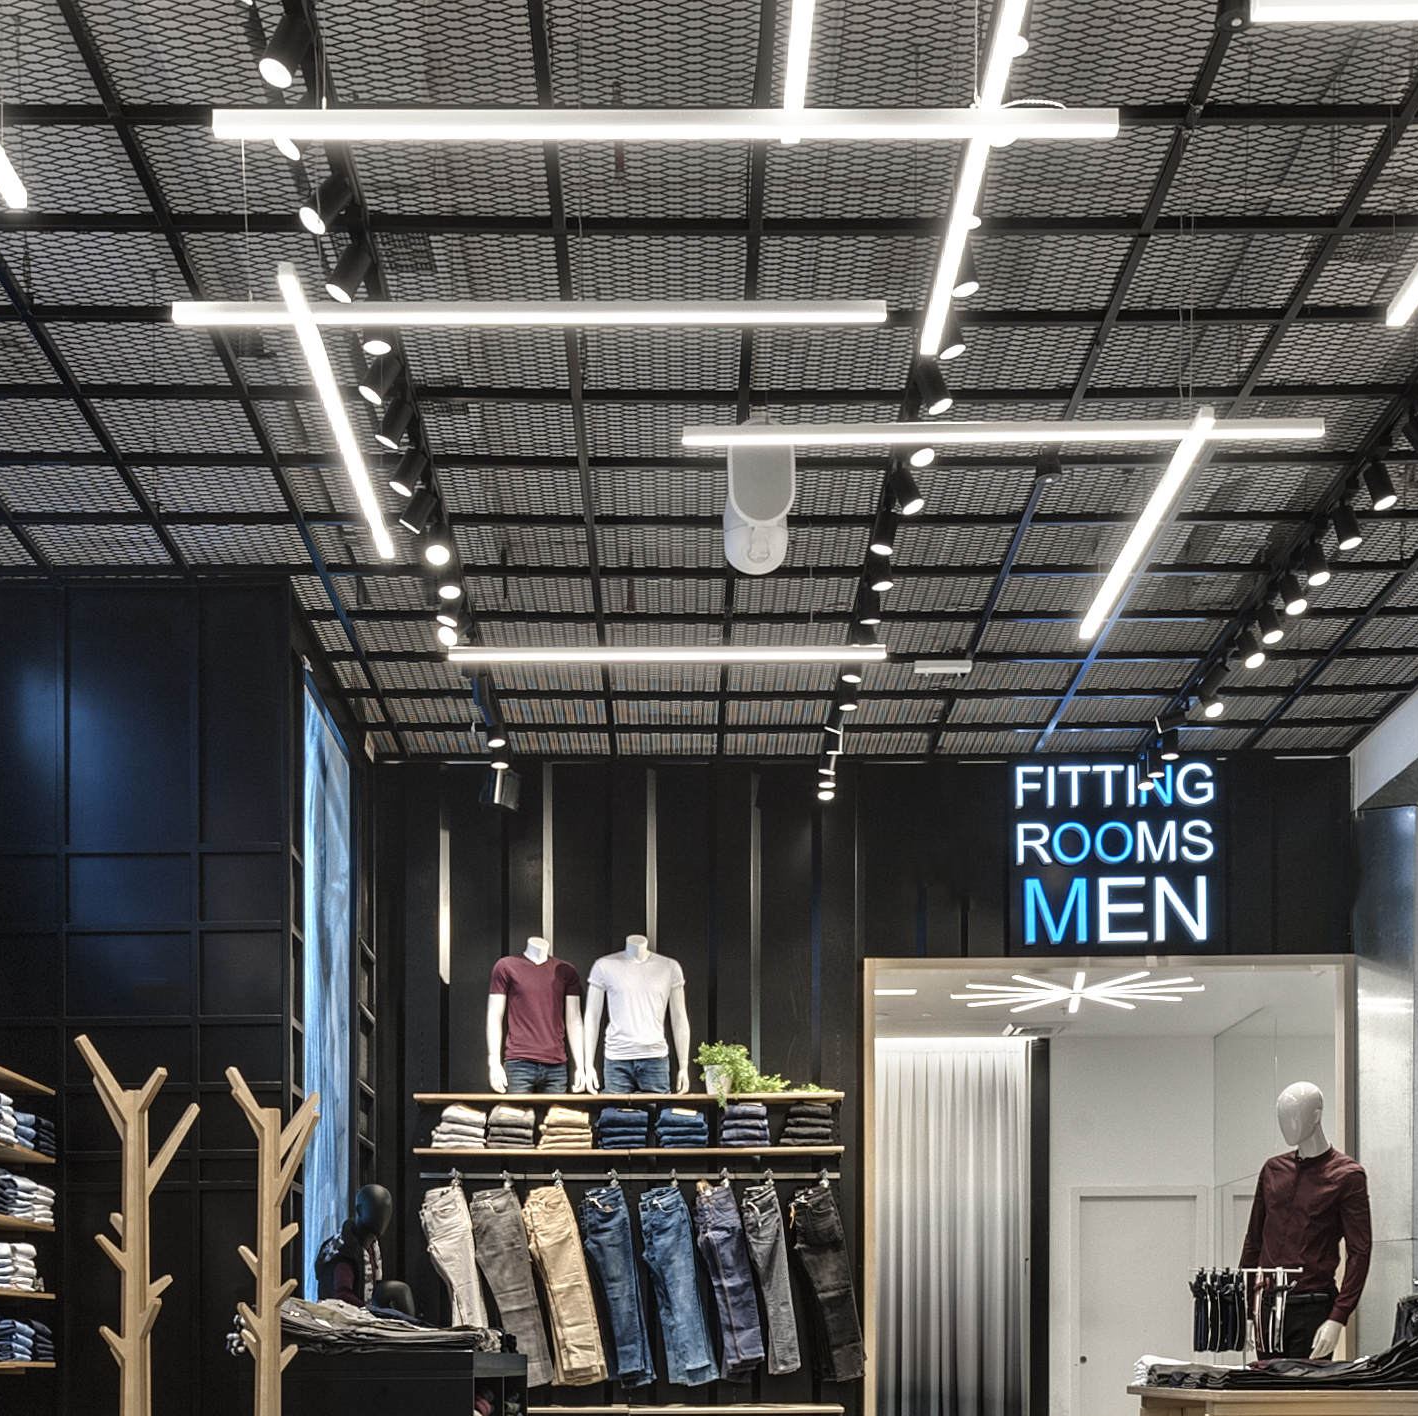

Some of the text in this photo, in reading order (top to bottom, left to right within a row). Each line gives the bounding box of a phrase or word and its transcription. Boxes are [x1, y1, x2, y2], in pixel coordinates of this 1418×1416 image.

[1015, 763, 1215, 808] FITTING
[1015, 820, 1215, 865] ROOMS
[1023, 875, 1208, 945] MEN
